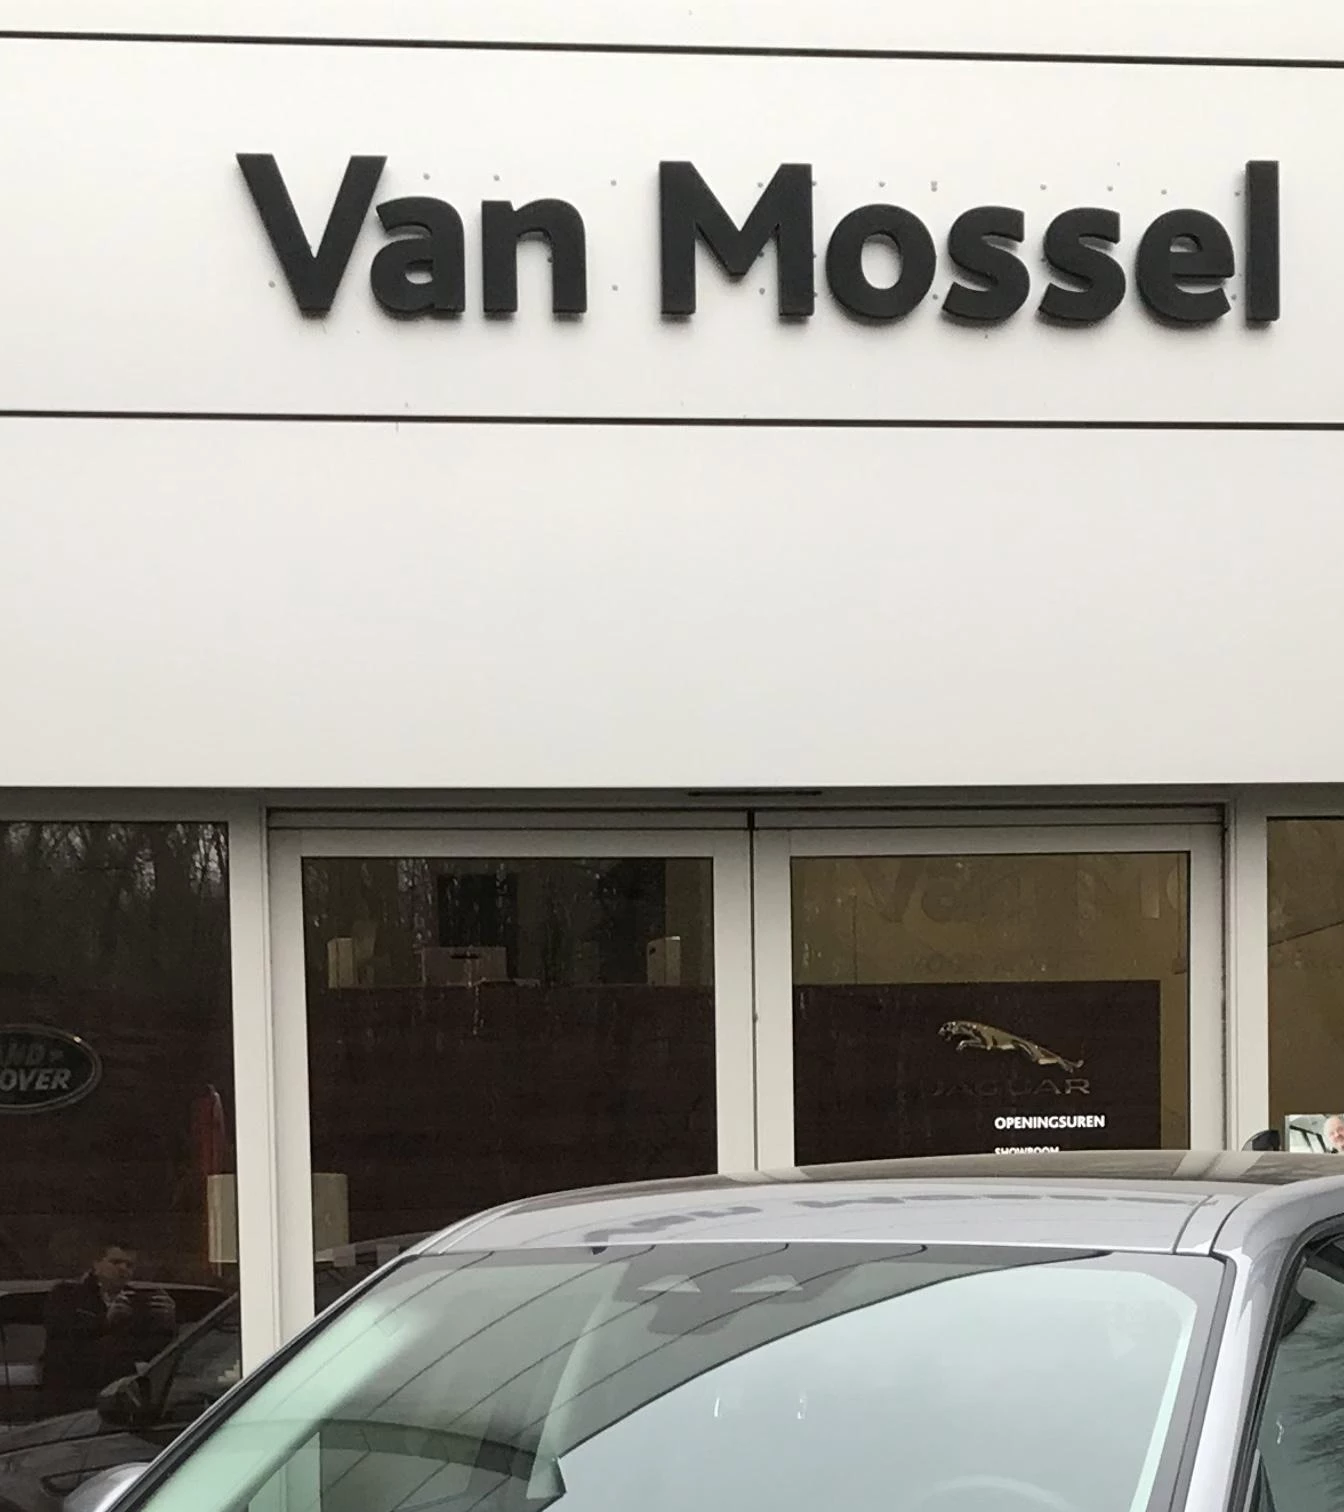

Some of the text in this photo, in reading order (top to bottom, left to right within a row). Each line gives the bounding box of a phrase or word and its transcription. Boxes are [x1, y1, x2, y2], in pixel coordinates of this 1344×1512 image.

[236, 152, 1281, 323] Van Mossel
[932, 1078, 1091, 1096] JAGUAR
[994, 1115, 1106, 1130] OPENINGSUREN
